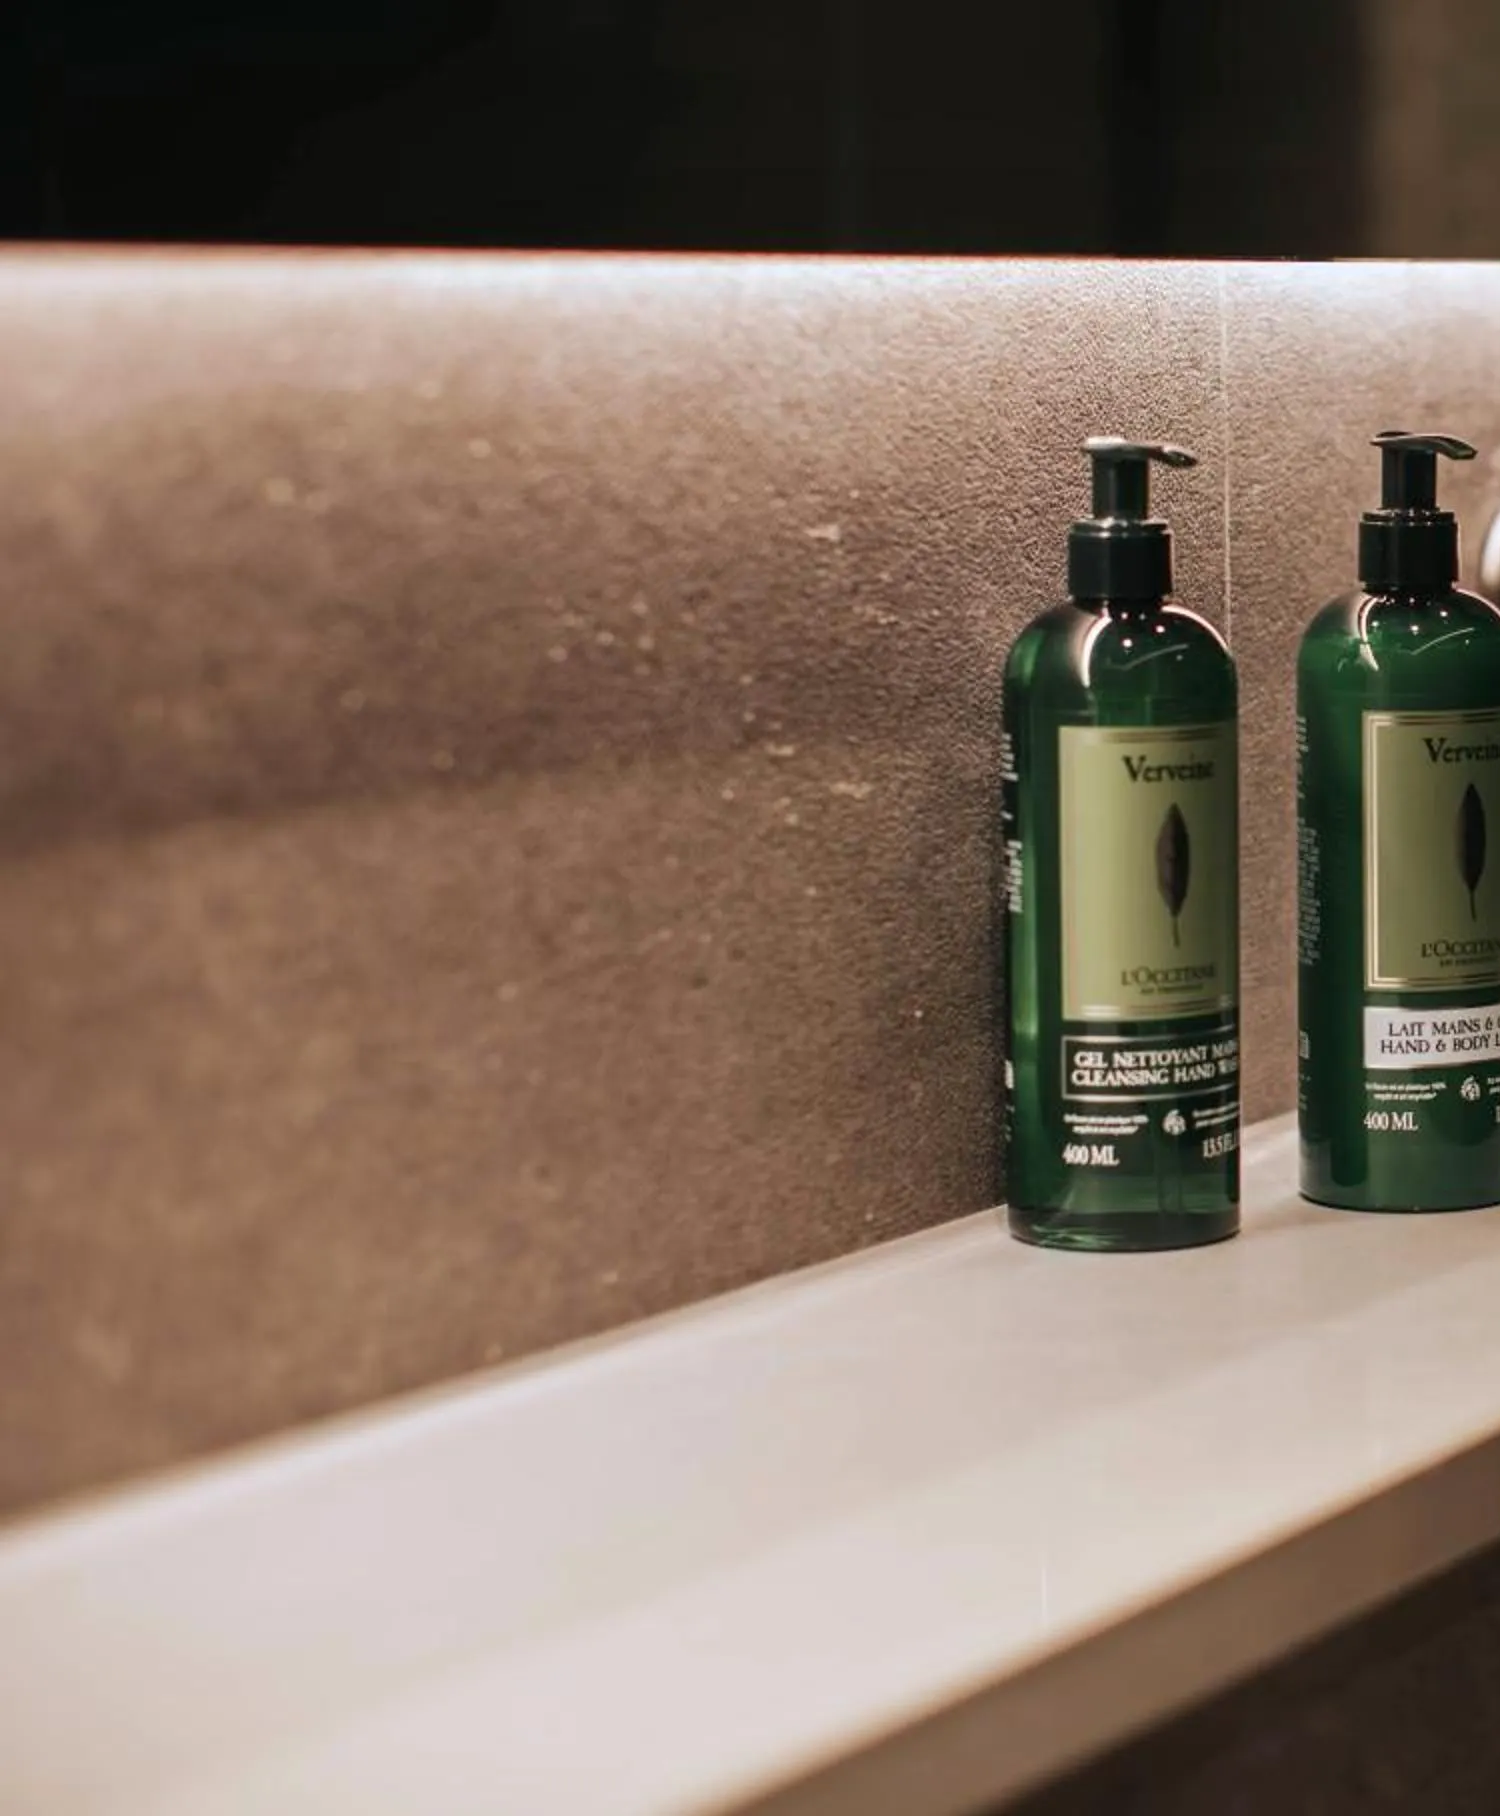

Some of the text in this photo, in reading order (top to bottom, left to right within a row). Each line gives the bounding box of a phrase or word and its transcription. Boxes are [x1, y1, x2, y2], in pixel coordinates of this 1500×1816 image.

[1388, 1022, 1424, 1037] LAIT
[1432, 1018, 1481, 1036] MAINS
[1381, 1039, 1430, 1054] HAND
[1435, 1040, 1447, 1053] &
[1453, 1034, 1491, 1051] BODY
[1074, 1051, 1108, 1068] GEL
[1113, 1045, 1208, 1068] NETTOYANT
[1071, 1068, 1169, 1087] CLEANSING
[1173, 1062, 1216, 1083] HAND
[1363, 1112, 1389, 1130] 400
[1391, 1111, 1419, 1131] ML
[1062, 1143, 1089, 1164] 400
[1090, 1144, 1120, 1165] ML
